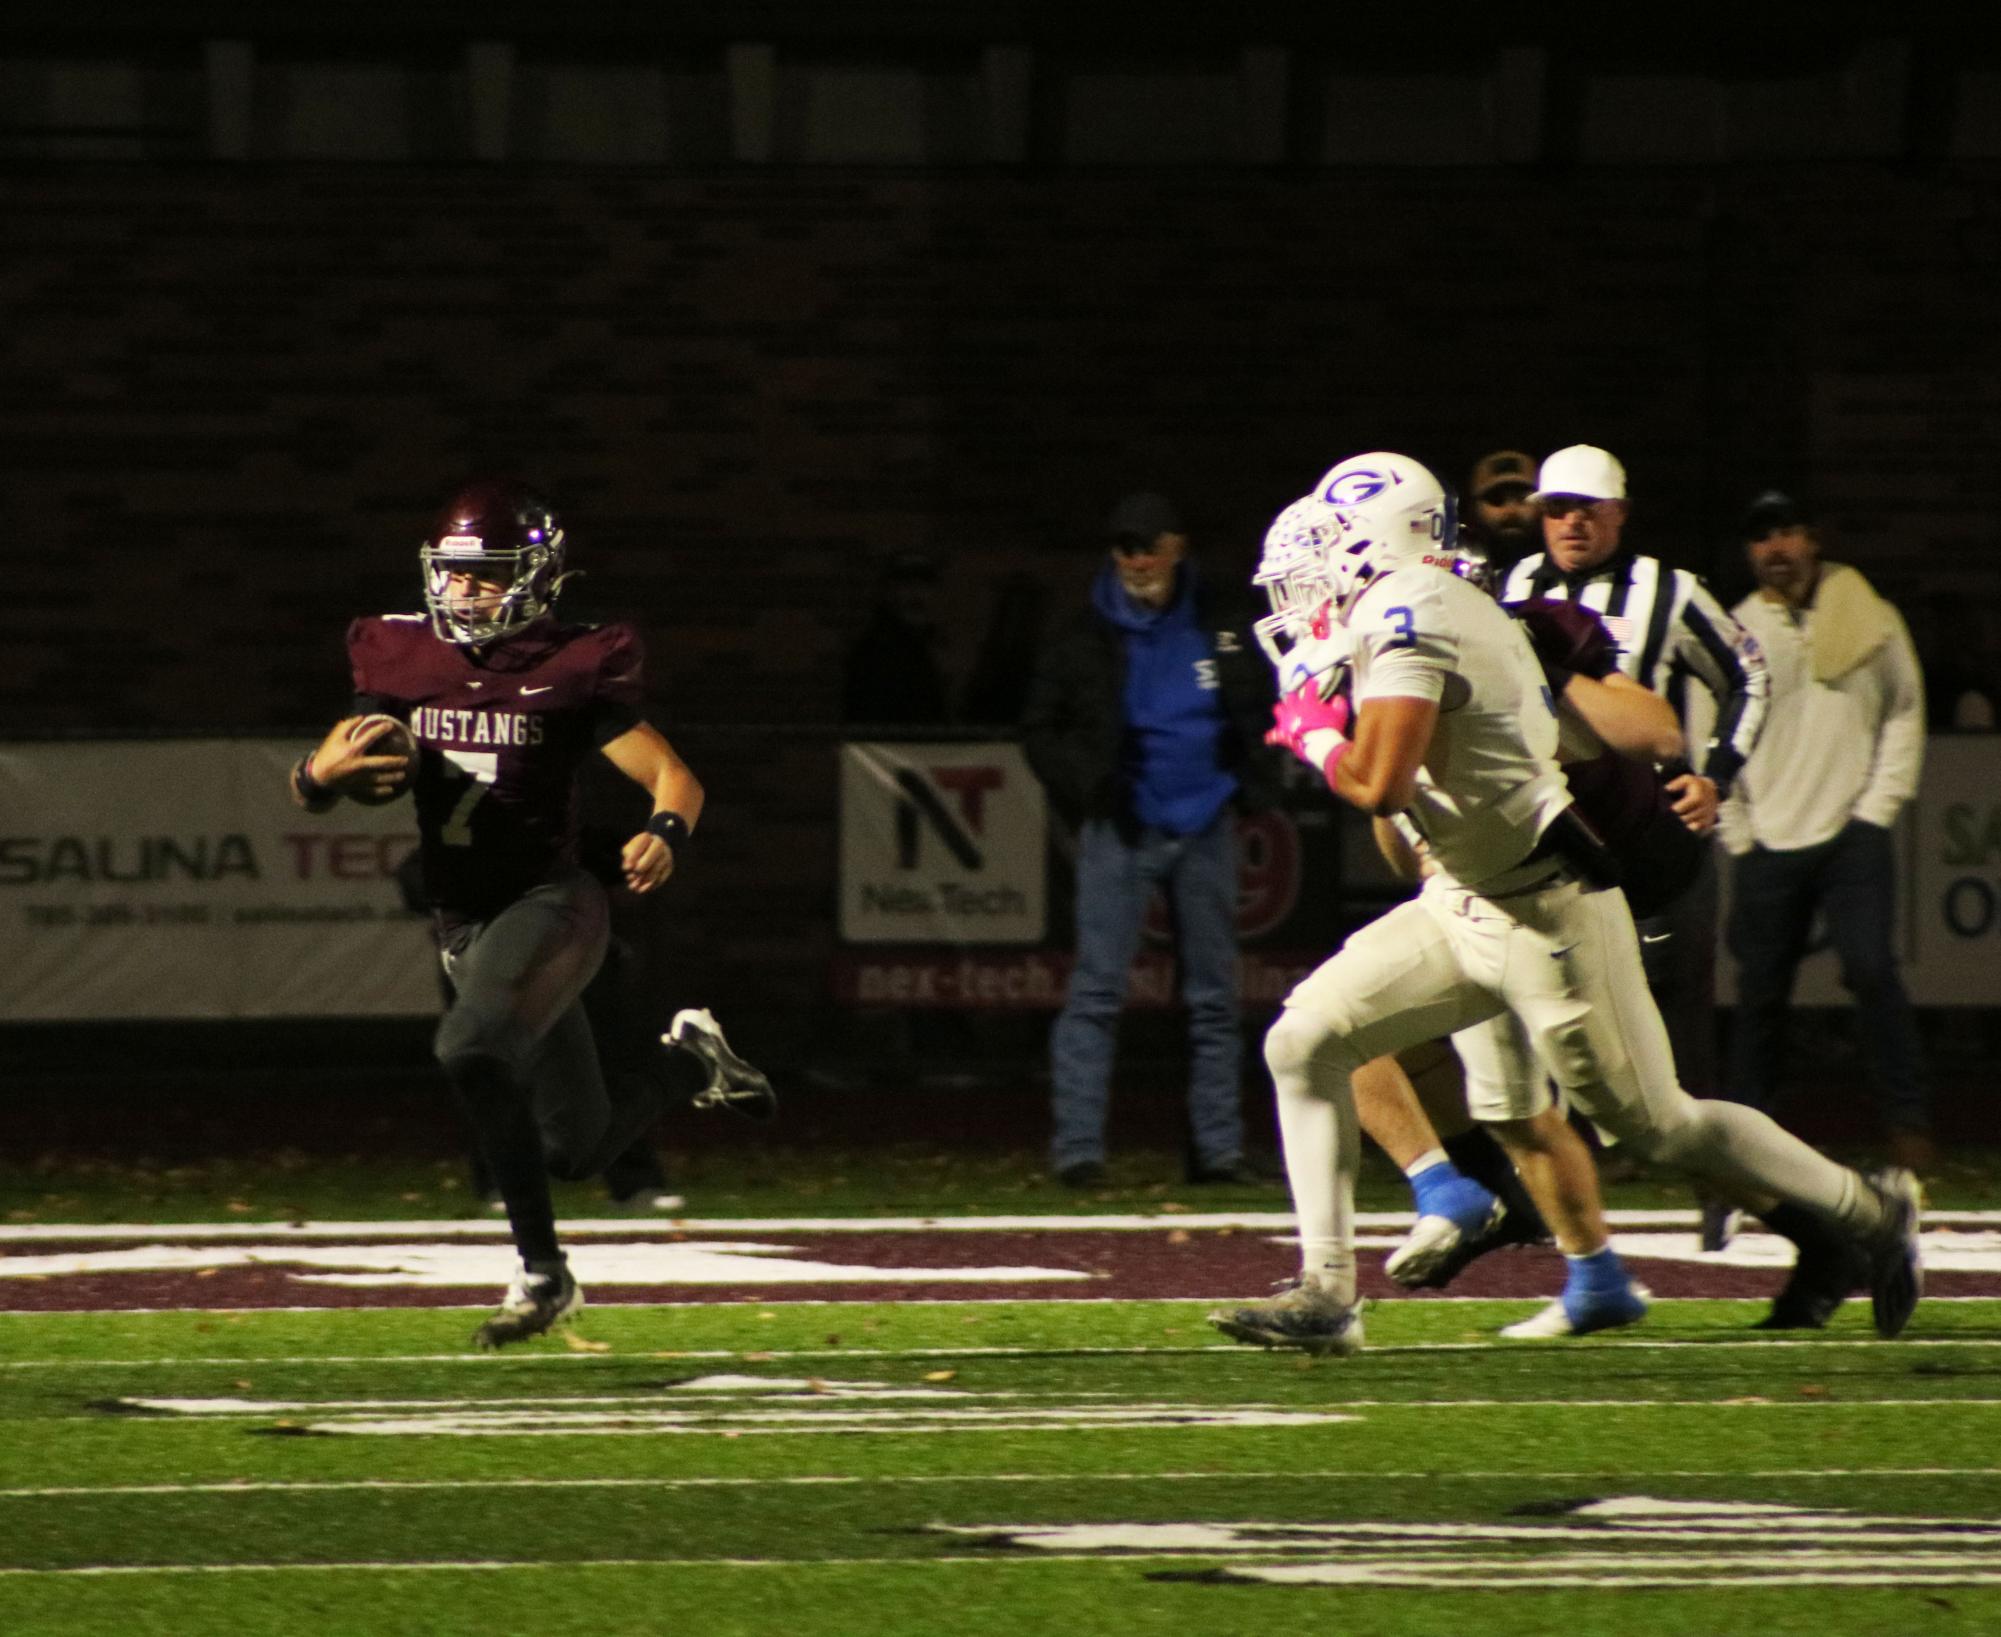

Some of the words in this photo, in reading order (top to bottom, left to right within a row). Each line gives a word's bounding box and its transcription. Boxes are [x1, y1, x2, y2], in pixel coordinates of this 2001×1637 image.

[1383, 606, 1418, 648] 3
[442, 749, 498, 846] 7
[0, 834, 259, 883] SALINA
